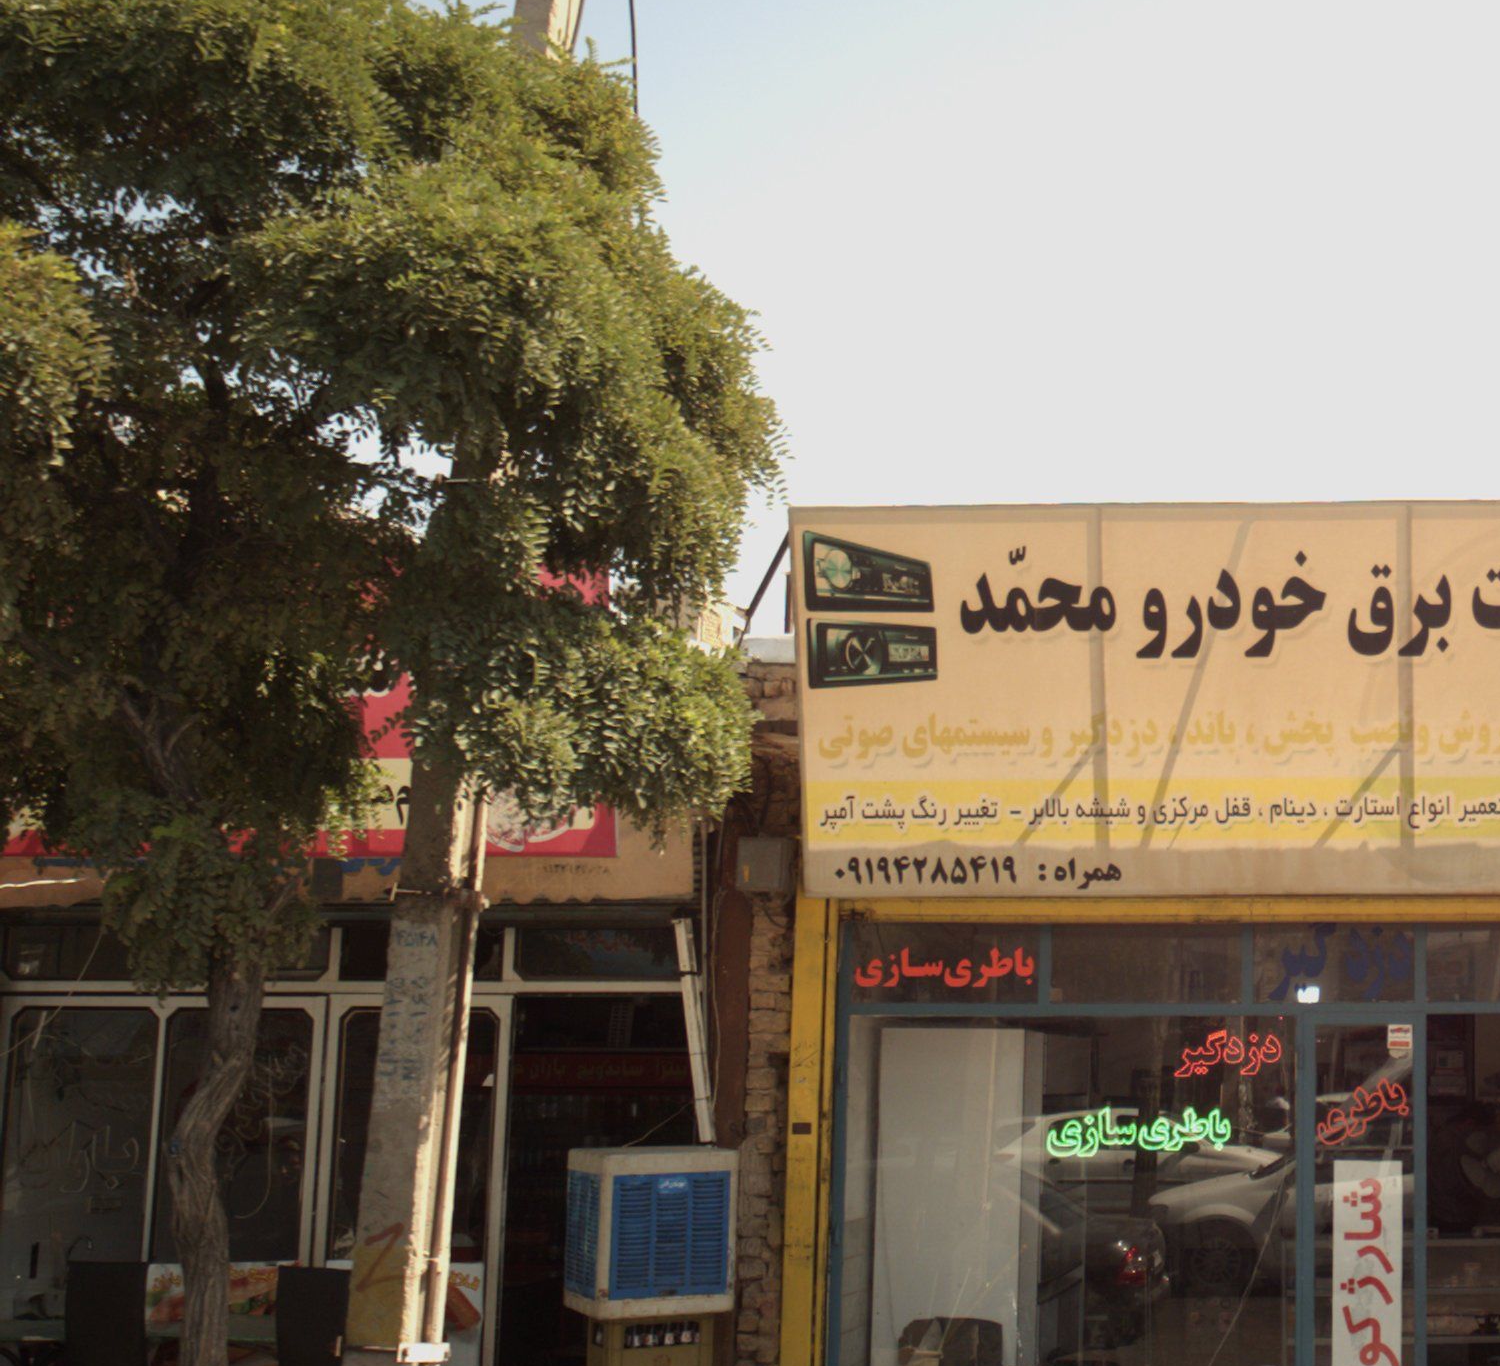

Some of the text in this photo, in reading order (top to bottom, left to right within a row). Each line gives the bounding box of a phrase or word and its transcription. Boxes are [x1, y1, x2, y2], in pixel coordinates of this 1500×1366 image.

[1136, 550, 1327, 659] خودرو
[1347, 564, 1453, 657] برق
[818, 714, 895, 761] صوتی
[902, 713, 1031, 759] سیستمهای
[1040, 726, 1054, 758] و
[1264, 711, 1334, 756] پخش
[819, 795, 857, 828] آمپر
[861, 797, 906, 831] پشت
[911, 795, 948, 826] رنگ
[953, 797, 998, 827] تغییر
[1028, 797, 1070, 826] بالابر
[1076, 796, 1131, 825] شیشه
[1137, 803, 1147, 825] و
[1152, 796, 1209, 826] مرکزی
[1215, 796, 1252, 826] قفل
[1270, 796, 1317, 826] دینام
[1335, 796, 1401, 824] استارت
[1408, 795, 1452, 829] انواع
[834, 854, 1017, 886] ۰۹۱۹۴۲۸۵۴۱۹
[855, 947, 1035, 987] باطری سازی
[1316, 1078, 1410, 1146] باطری
[1046, 1105, 1232, 1158] باطری سازی
[1340, 1177, 1395, 1306] شارژ
